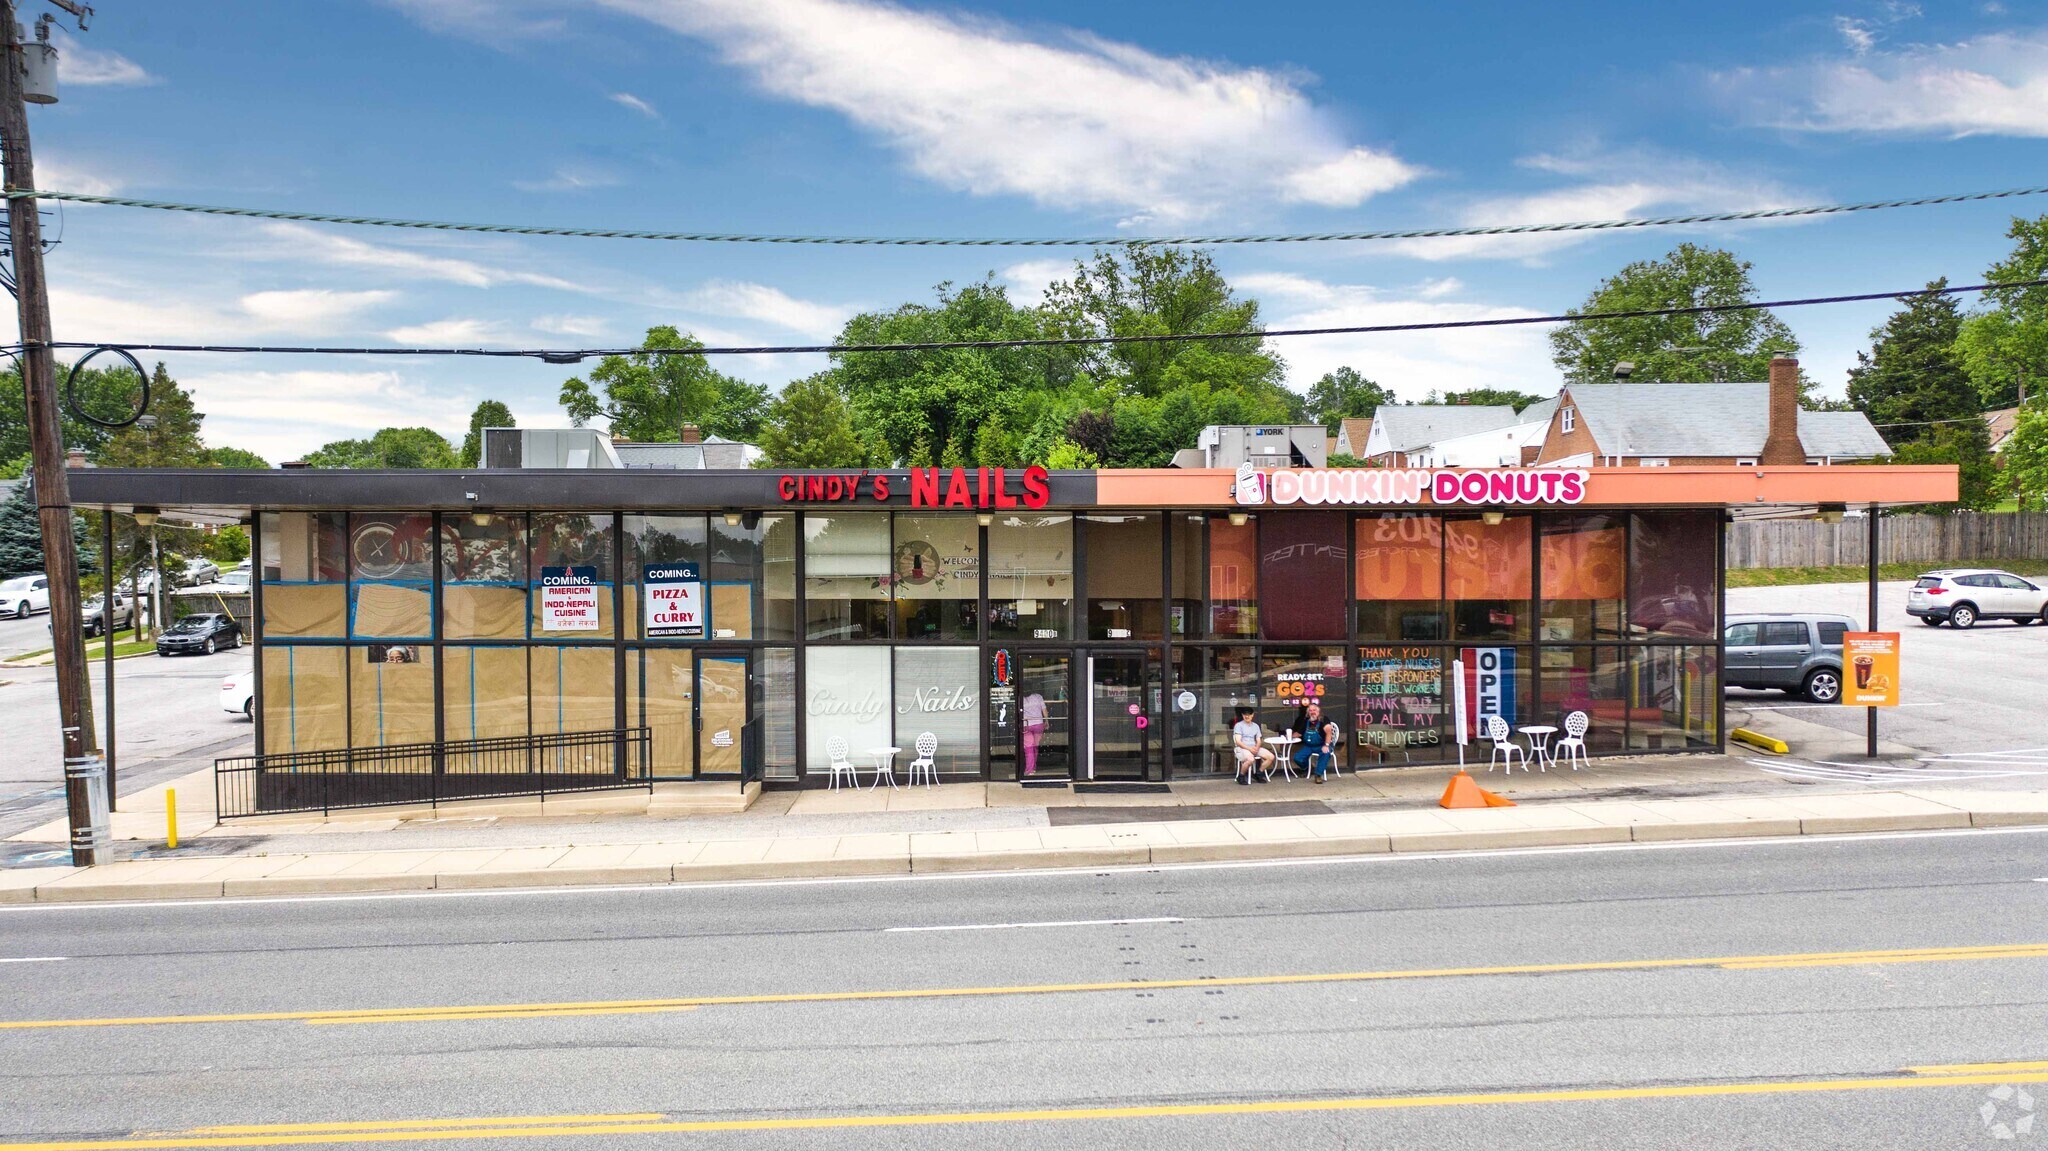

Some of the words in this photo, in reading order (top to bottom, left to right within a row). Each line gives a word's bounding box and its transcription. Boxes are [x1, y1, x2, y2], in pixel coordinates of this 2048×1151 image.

[778, 470, 890, 501] CINDY'S
[911, 465, 1049, 509] NAILS
[1273, 471, 1430, 502] DUNKIN'
[1434, 471, 1583, 502] DONUTS
[649, 568, 697, 579] COMING..
[543, 576, 596, 585] COMING..
[653, 589, 688, 599] PIZZA
[545, 600, 595, 608] INDO-NEPALI
[669, 602, 677, 610] &
[653, 612, 694, 623] CURRY
[1358, 647, 1393, 658] THANK
[1402, 647, 1430, 658] YOU
[1405, 658, 1441, 670] NURSES
[1360, 671, 1384, 684] FIRST
[1387, 669, 1441, 683] RESPONDERS
[808, 688, 885, 725] Cindy
[897, 685, 977, 714] Nails
[1357, 697, 1399, 710] THANK
[1136, 716, 1148, 728] D
[1356, 713, 1373, 726] TO
[1381, 713, 1406, 726] ALL
[1413, 713, 1434, 726] MY
[1358, 729, 1439, 746] EMPLOYEES
